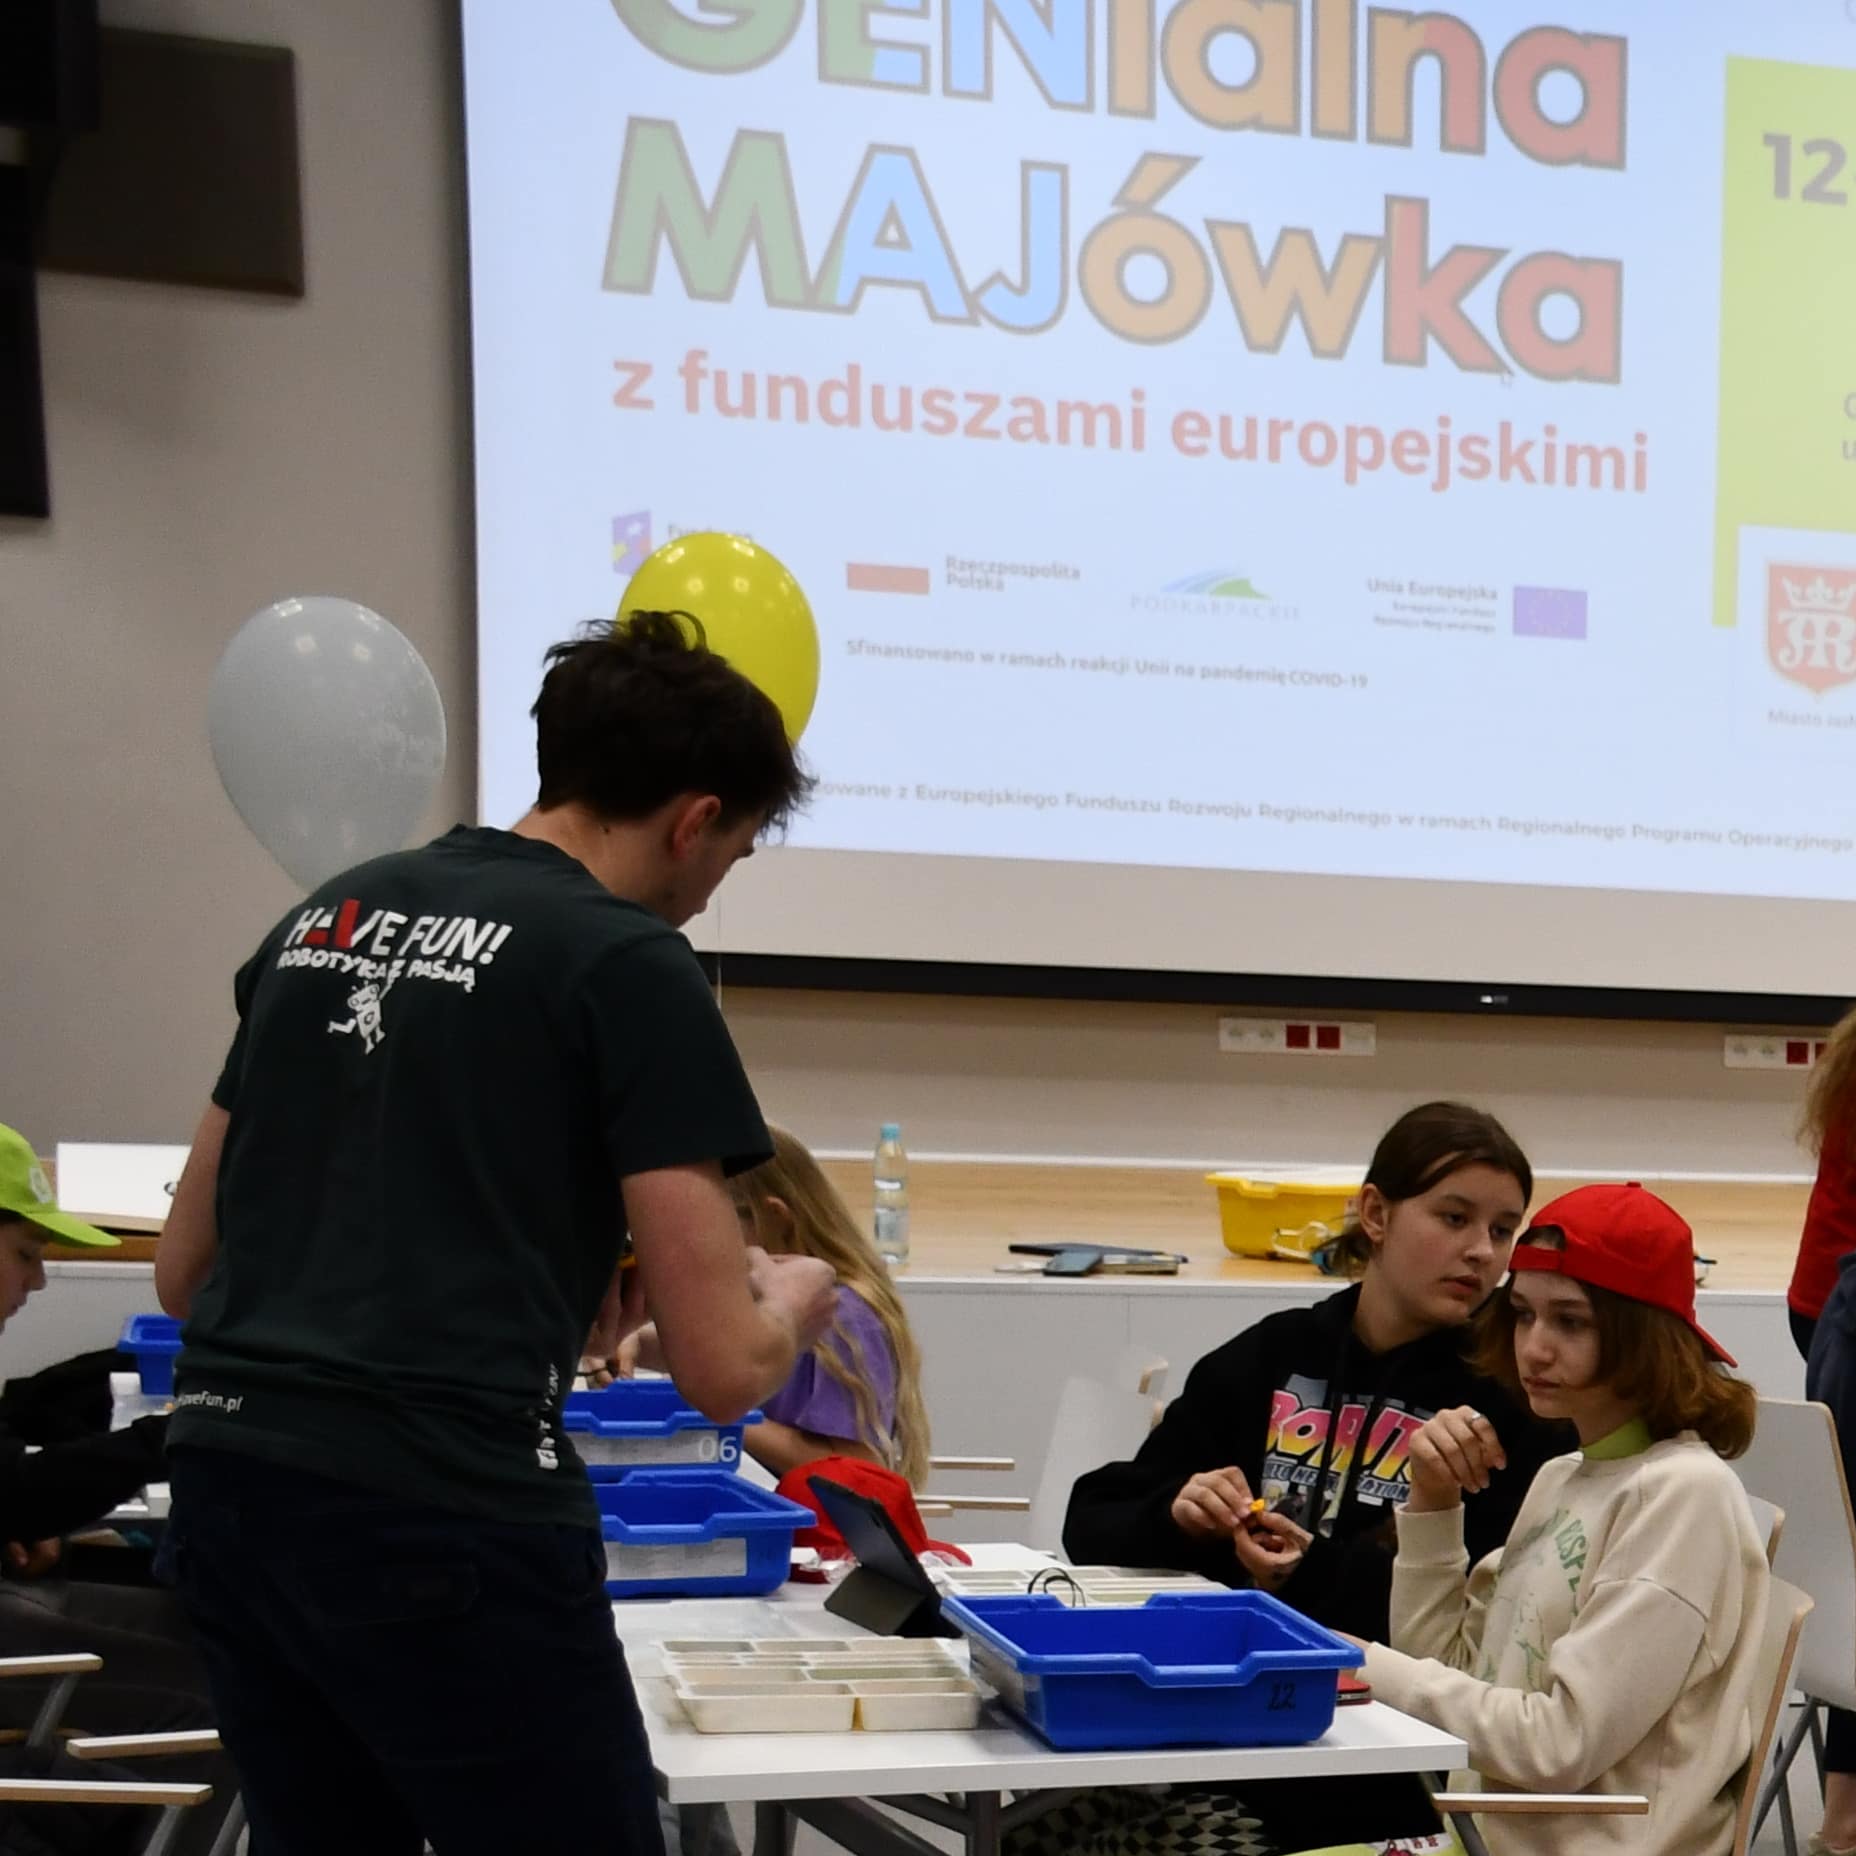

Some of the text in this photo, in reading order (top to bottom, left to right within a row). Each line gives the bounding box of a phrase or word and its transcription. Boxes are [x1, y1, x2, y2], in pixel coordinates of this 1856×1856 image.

[601, 114, 1622, 385] MAJówka
[611, 349, 1649, 493] z funduszami europejskimi
[846, 639, 976, 663] Sfinansowano
[1000, 651, 1067, 669] ramach
[915, 784, 1059, 810] Europejskiego
[1065, 791, 1162, 813] Funduszu
[284, 899, 512, 965] HAVE FUN!
[276, 947, 387, 981] ROBOTYKA
[406, 959, 476, 993] PASJĄ
[698, 1435, 737, 1463] 06
